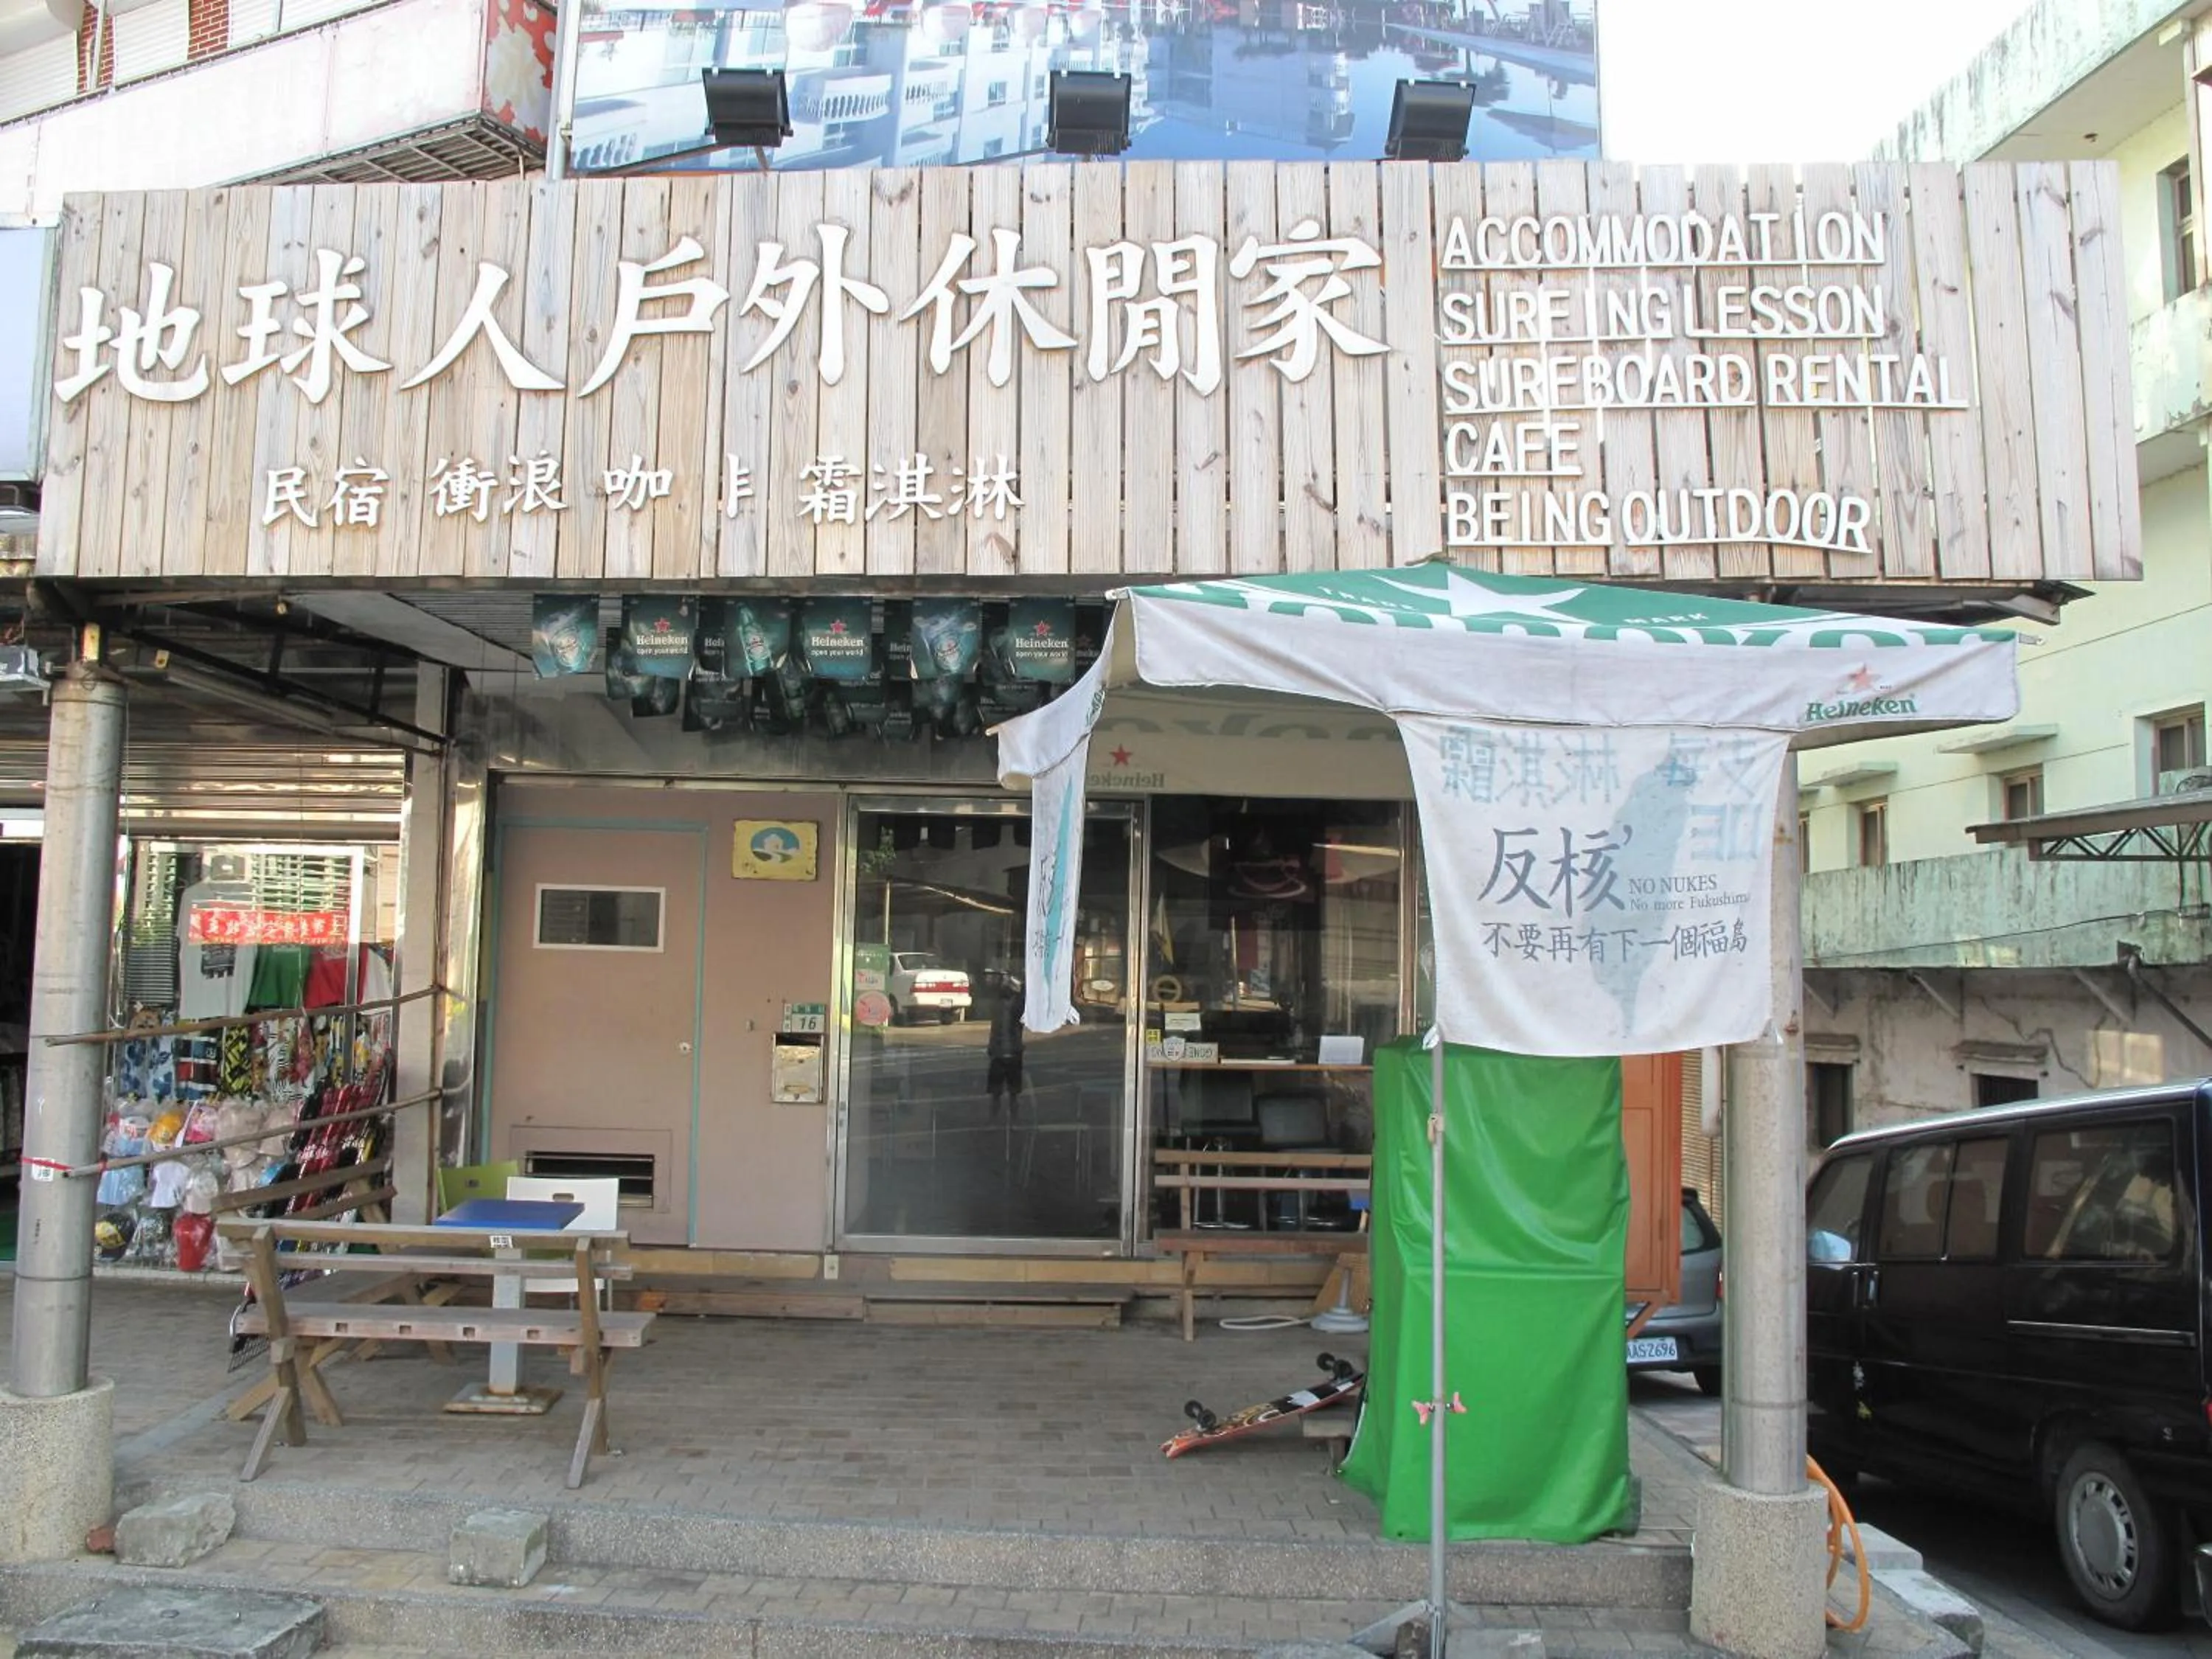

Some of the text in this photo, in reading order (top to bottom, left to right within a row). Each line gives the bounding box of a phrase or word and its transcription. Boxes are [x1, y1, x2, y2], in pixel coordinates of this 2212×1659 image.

[1441, 211, 1885, 269] ACCOMMODATION
[1441, 285, 1885, 344] SURFING LESSON
[1444, 353, 1969, 414] SURFBOARD RENTAL
[1447, 421, 1583, 476] CAFE
[261, 455, 388, 528] 民宿
[429, 450, 569, 524] 衝浪
[796, 452, 1026, 526] 霜淇淋
[1447, 487, 1874, 554] BEING OUTDOOR
[636, 636, 688, 646] Heineken
[812, 636, 863, 647] Heineken
[1015, 638, 1068, 648] Heineken
[1806, 694, 1917, 722] Heineken
[1629, 874, 1717, 894] NO NUKES
[1630, 899, 1648, 911] No
[1654, 900, 1683, 911] more
[1481, 918, 1747, 963] 不要再有下一個福島
